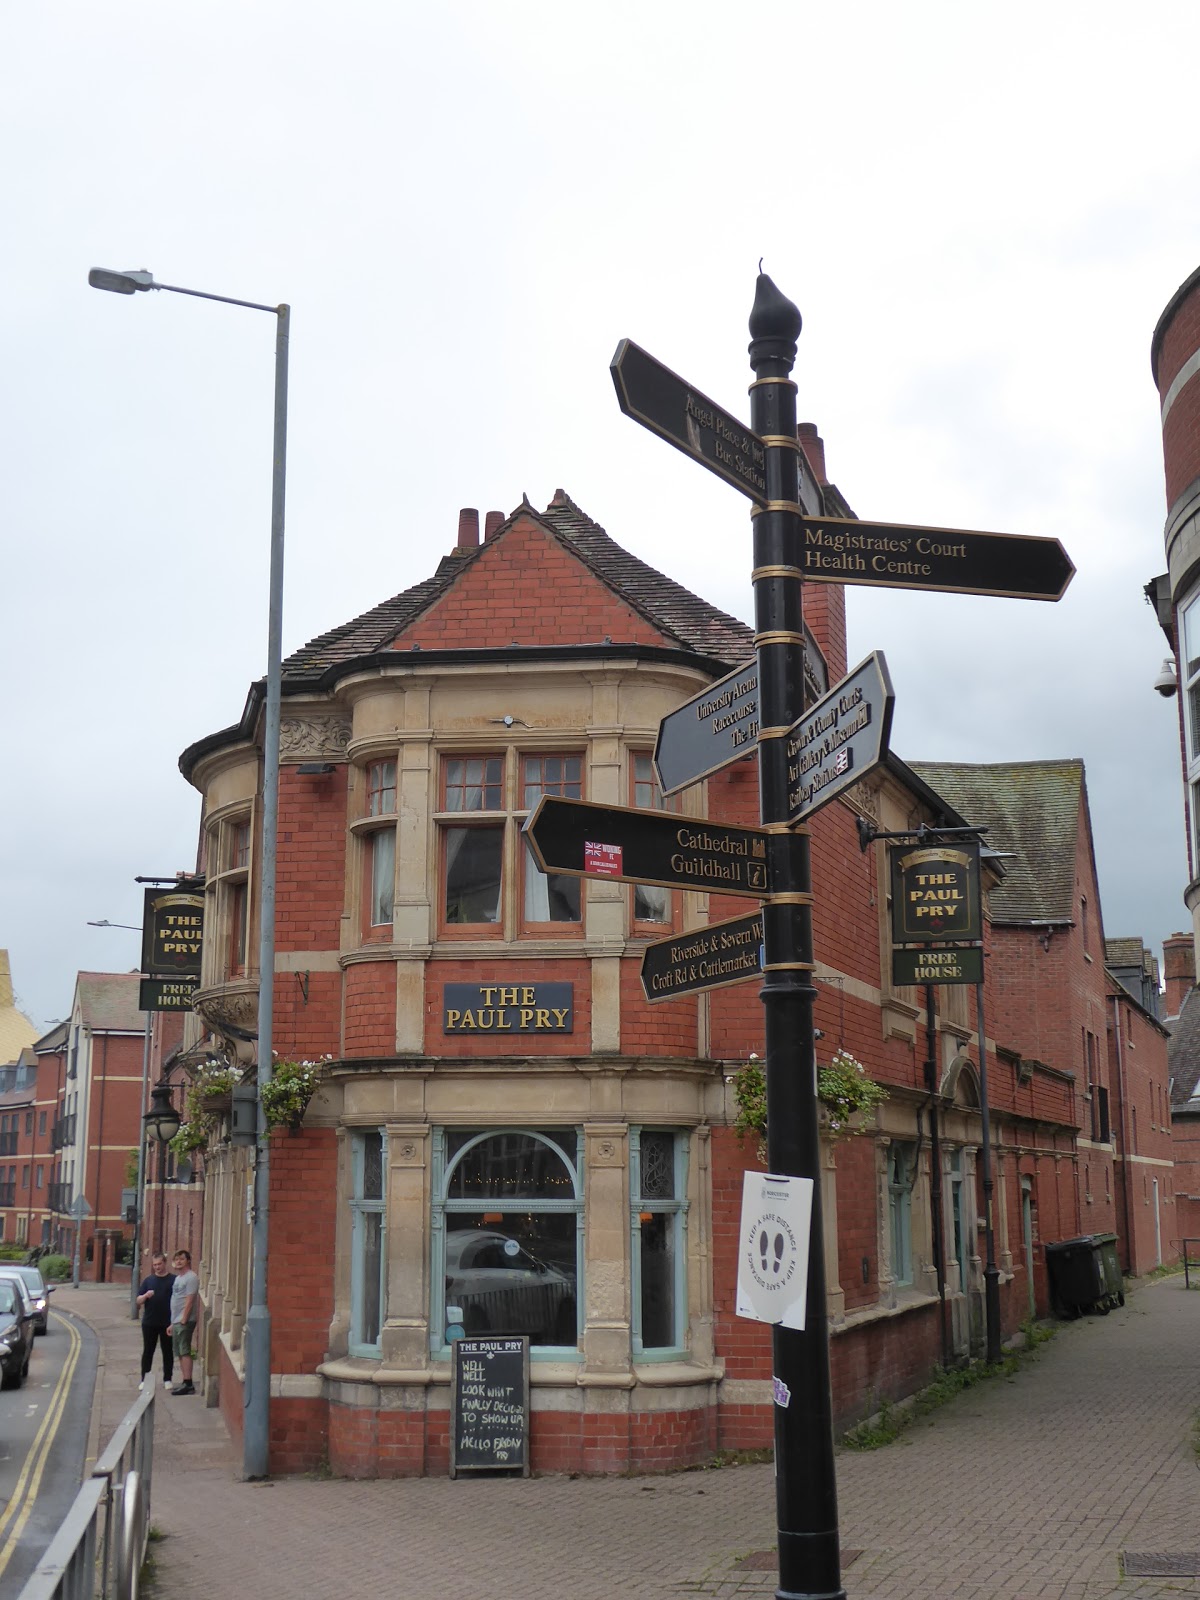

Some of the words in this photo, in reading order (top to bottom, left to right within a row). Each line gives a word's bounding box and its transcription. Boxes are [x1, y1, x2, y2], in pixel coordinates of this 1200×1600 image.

[685, 395, 714, 429] Angel
[716, 417, 740, 447] Place
[741, 438, 750, 455] &
[715, 440, 733, 466] Bus
[735, 455, 766, 489] Station
[916, 538, 967, 558] Court
[804, 551, 866, 570] Health
[872, 555, 932, 575] Centre
[696, 690, 733, 721] University
[733, 677, 757, 700] Arena
[712, 700, 755, 735] Racecourse
[814, 708, 837, 736] County
[731, 726, 746, 747] The
[788, 763, 800, 784] Art
[800, 748, 823, 774] Gallery
[830, 719, 860, 752] Museum
[789, 784, 813, 810] Railway
[677, 828, 747, 856] Cathedral
[671, 854, 741, 881] Guildhall
[915, 873, 957, 885] THE
[910, 889, 964, 901] PAUL
[916, 905, 959, 917] PRY
[166, 915, 201, 925] THE
[160, 929, 203, 939] PAUL
[164, 943, 200, 953] PRY
[671, 941, 708, 963] Riverside
[710, 935, 719, 952] &
[721, 930, 752, 949] Severn
[918, 952, 957, 965] FREE
[652, 971, 673, 990] Croft
[675, 967, 688, 985] Rd
[689, 965, 698, 981] &
[700, 950, 758, 978] Cattlemarket
[914, 966, 962, 978] HOUSE
[162, 984, 196, 994] FREE
[479, 987, 537, 1006] THE
[158, 995, 193, 1006] HOUS
[446, 1009, 512, 1029] PAUL
[519, 1008, 570, 1028] PRY
[748, 1225, 757, 1244] KEEP
[762, 1213, 775, 1222] SAFE
[776, 1216, 797, 1251] DISTANCE
[460, 1343, 477, 1351] THE
[480, 1342, 502, 1350] PAUL
[504, 1341, 522, 1350] PRY
[462, 1360, 485, 1371] WELL
[463, 1370, 486, 1381] WELL
[461, 1385, 485, 1396] LOOK
[487, 1386, 514, 1398] WHAT
[461, 1398, 492, 1411] FINALLY
[461, 1412, 477, 1422] TO
[481, 1413, 508, 1424] SHOW
[461, 1436, 490, 1450] HELLO
